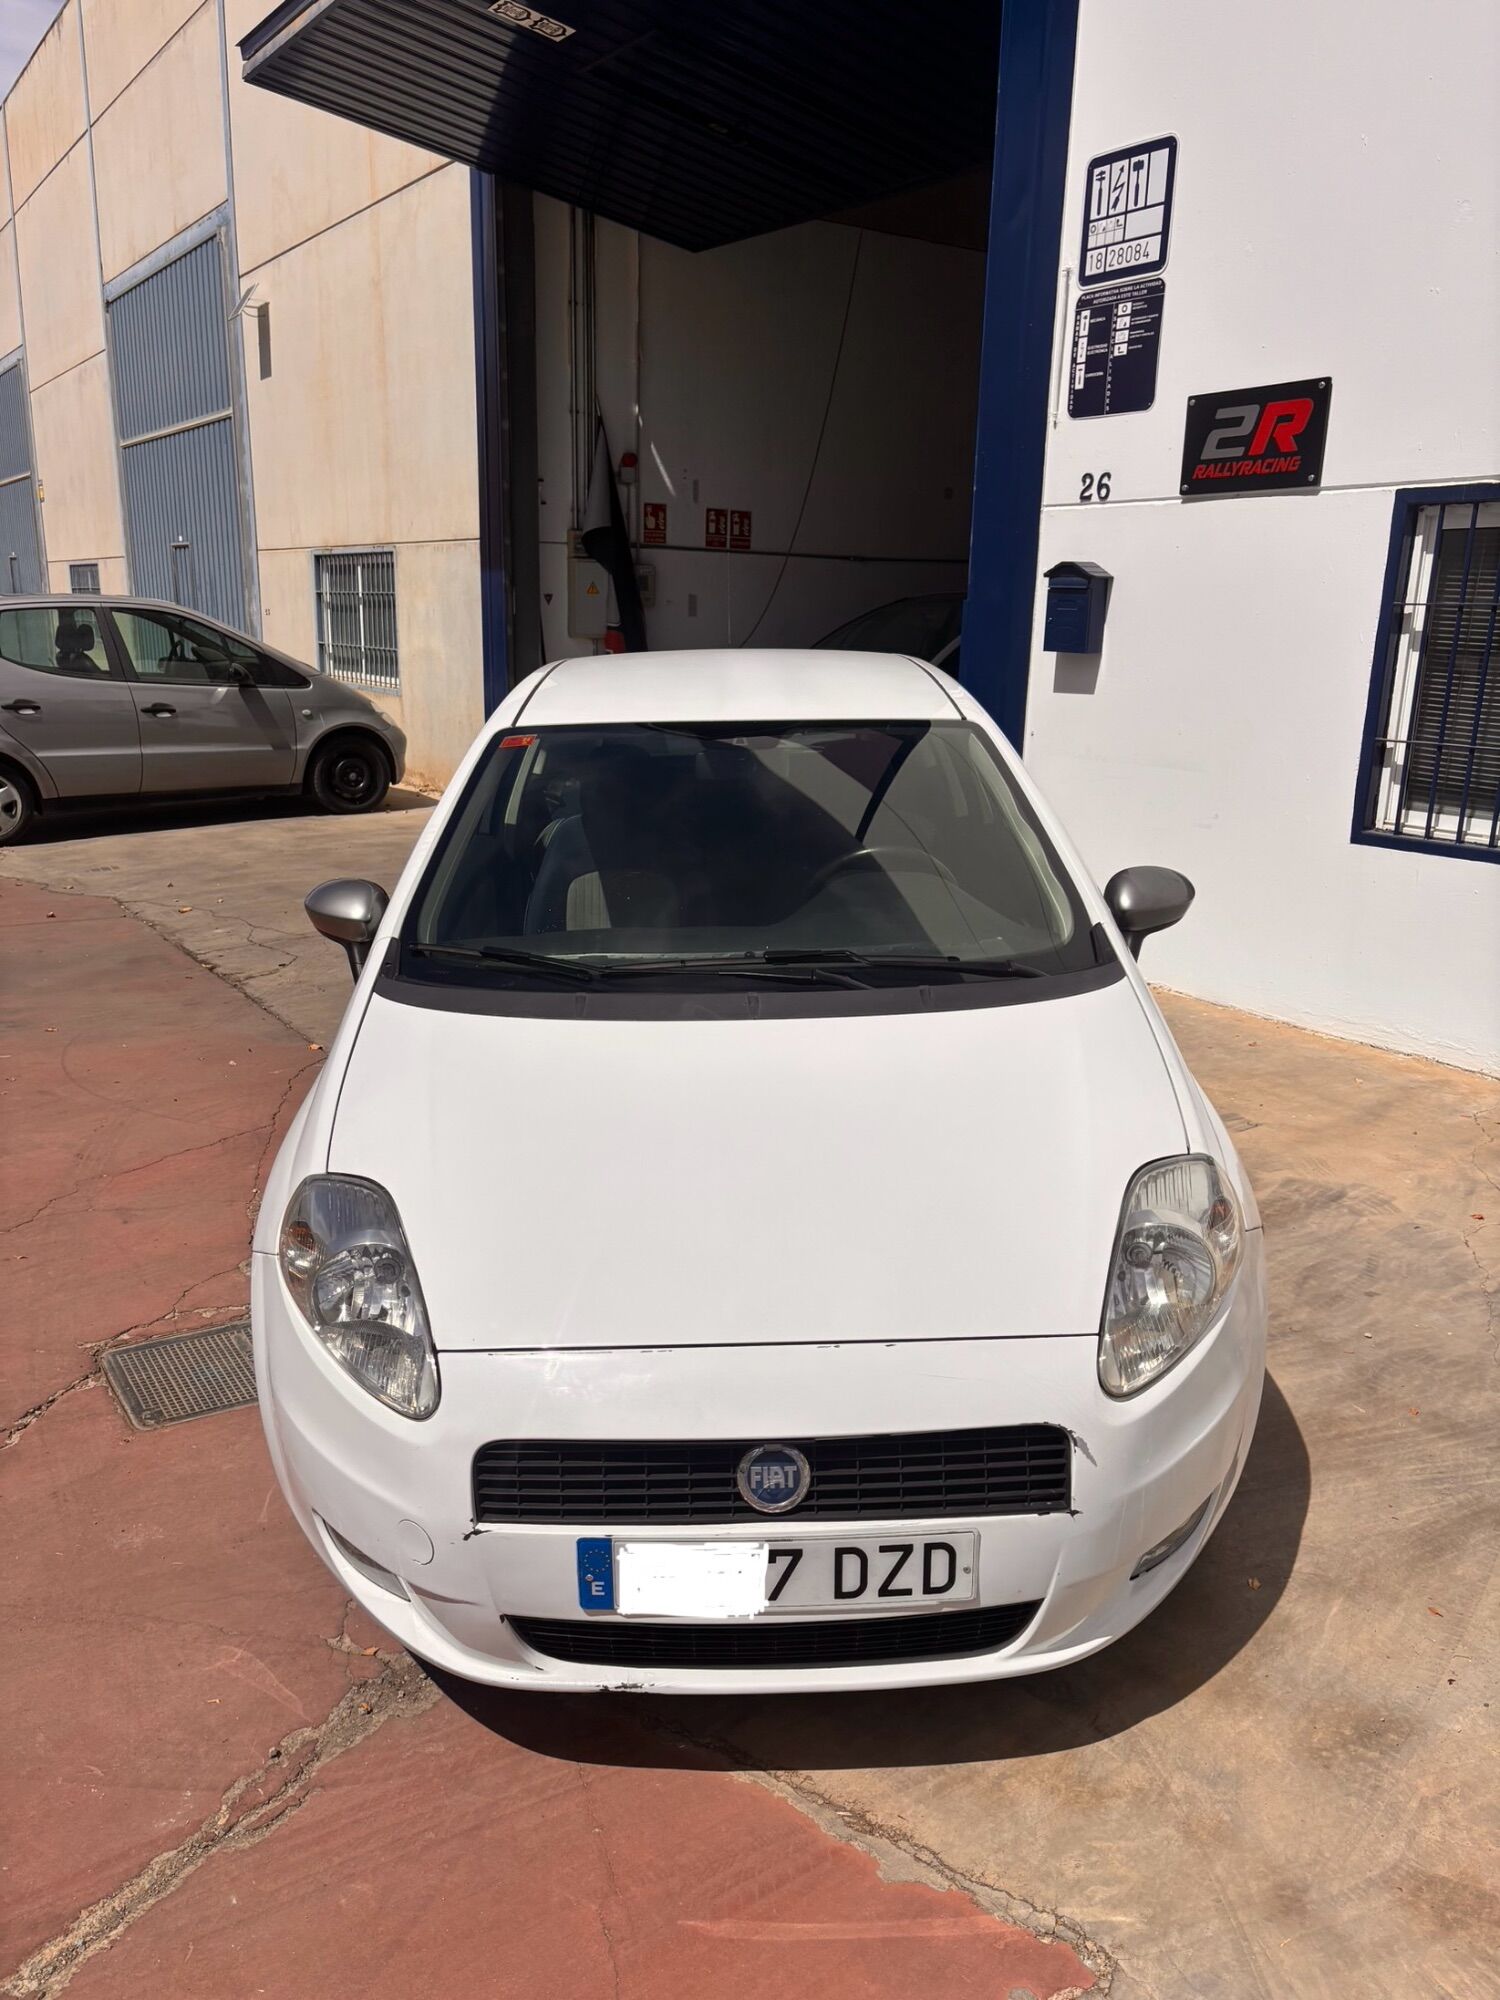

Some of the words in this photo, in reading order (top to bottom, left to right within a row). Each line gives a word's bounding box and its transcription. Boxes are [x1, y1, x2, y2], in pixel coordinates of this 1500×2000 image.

[1089, 252, 1104, 272] 18
[1108, 241, 1150, 267] 28084
[1200, 397, 1315, 460] 2R
[1192, 456, 1302, 480] RALLYRACING
[1079, 472, 1112, 502] 26
[750, 1465, 798, 1489] FIAT
[834, 1542, 957, 1600] DZD
[591, 1581, 605, 1596] E
